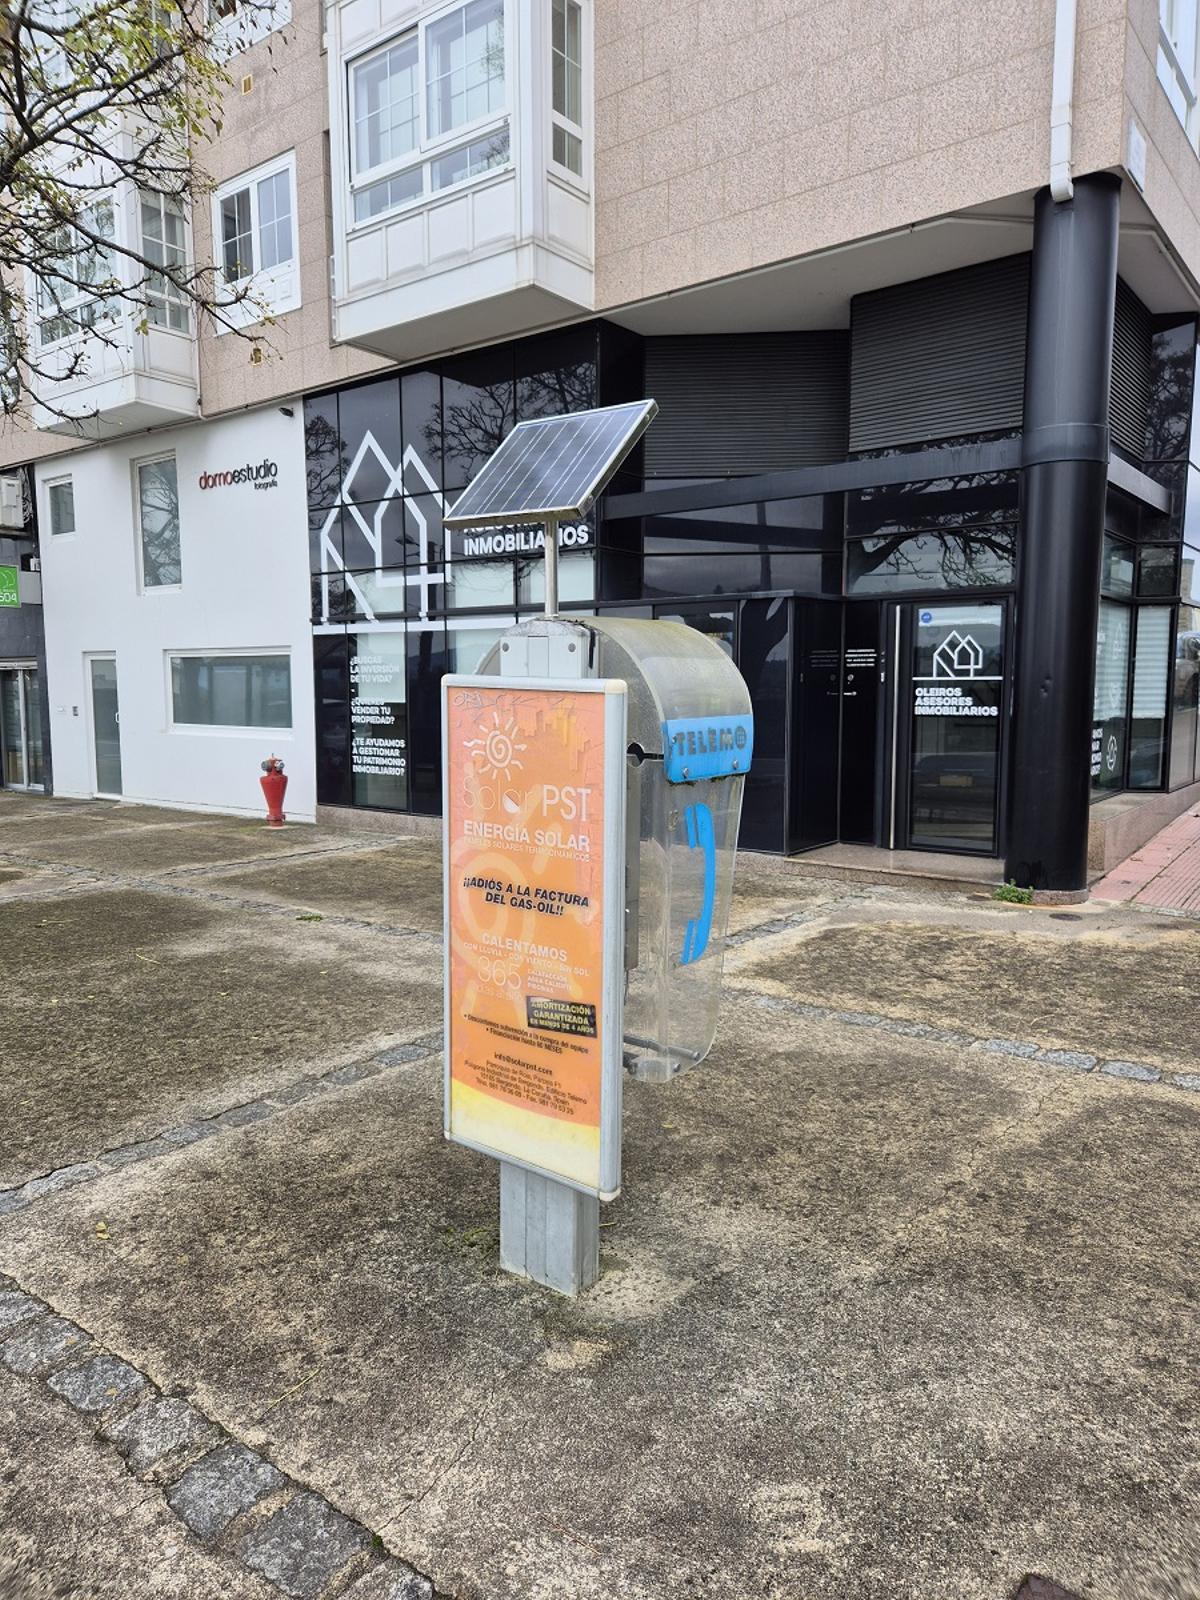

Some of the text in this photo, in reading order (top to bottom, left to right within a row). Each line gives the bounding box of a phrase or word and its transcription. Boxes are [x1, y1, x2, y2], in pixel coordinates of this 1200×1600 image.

[199, 458, 277, 490] domoestudio
[464, 525, 589, 556] INMOBILIAIOS
[350, 665, 360, 674] LA
[350, 674, 393, 684] DE TU VIDA?
[915, 687, 962, 697] OLEIROS
[914, 697, 973, 706] ASESORES
[351, 706, 391, 715] VENDER TU
[914, 706, 998, 716] INMOBILIARIOS
[351, 715, 395, 725] PROPIEDAD?
[352, 737, 405, 748] ¿TE AYUDAMOS
[359, 747, 400, 757] GESTIONAR
[353, 756, 406, 767] TU PATRIMONIO
[353, 765, 404, 776] INMOBILIARIO?
[542, 784, 592, 822] PST
[464, 819, 591, 853] ENERGÍA SOLAR
[463, 876, 589, 908] ¡¡ADIÓS A LA FACTURA
[485, 892, 565, 917] DEL GAS-OIL!!
[482, 933, 568, 962] CALENTAMOS
[478, 956, 522, 990] 365
[531, 1001, 591, 1015] AMORTIZACIÓN
[534, 1011, 589, 1026] GARANTIZADA
[577, 1025, 594, 1034] AÑOS
[544, 1043, 563, 1055] MESES
